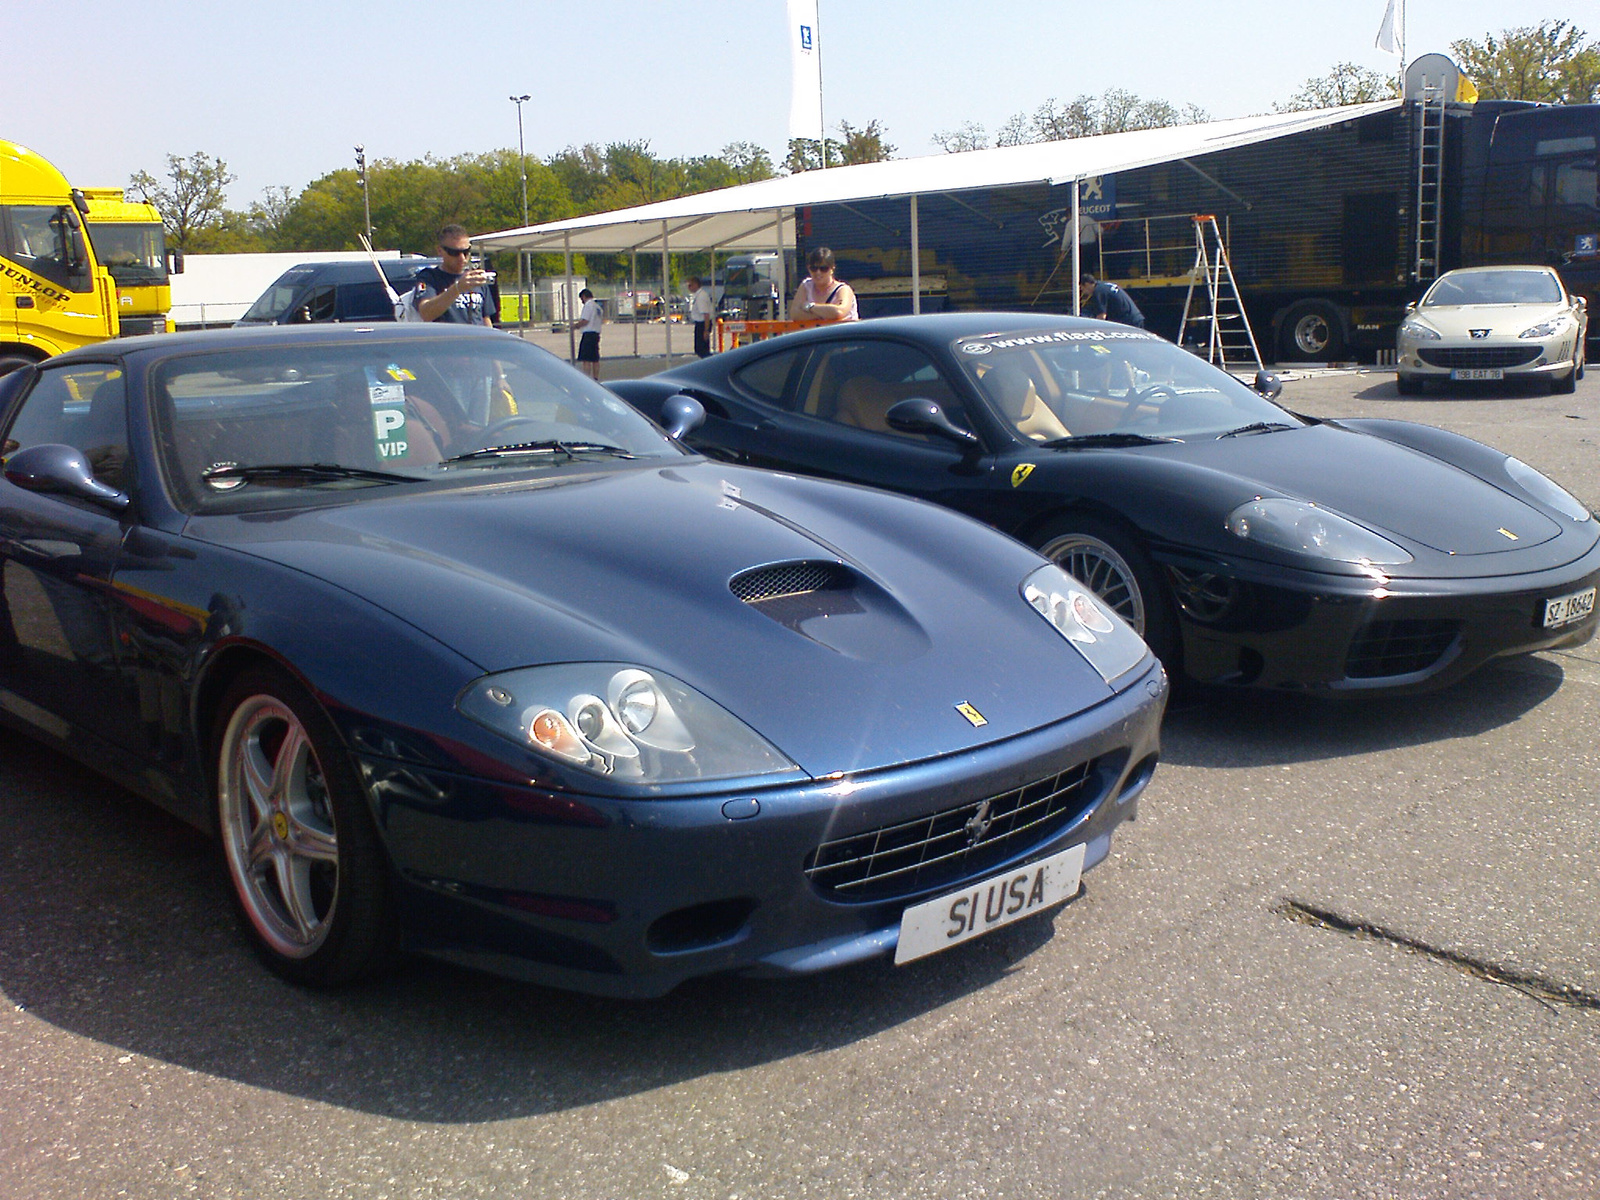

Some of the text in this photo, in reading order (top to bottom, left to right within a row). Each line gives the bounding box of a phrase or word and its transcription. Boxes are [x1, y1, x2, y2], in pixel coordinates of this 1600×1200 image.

[1079, 204, 1111, 215] EUGEOT
[375, 409, 405, 440] P
[378, 441, 408, 457] VIP
[985, 866, 1045, 923] USA
